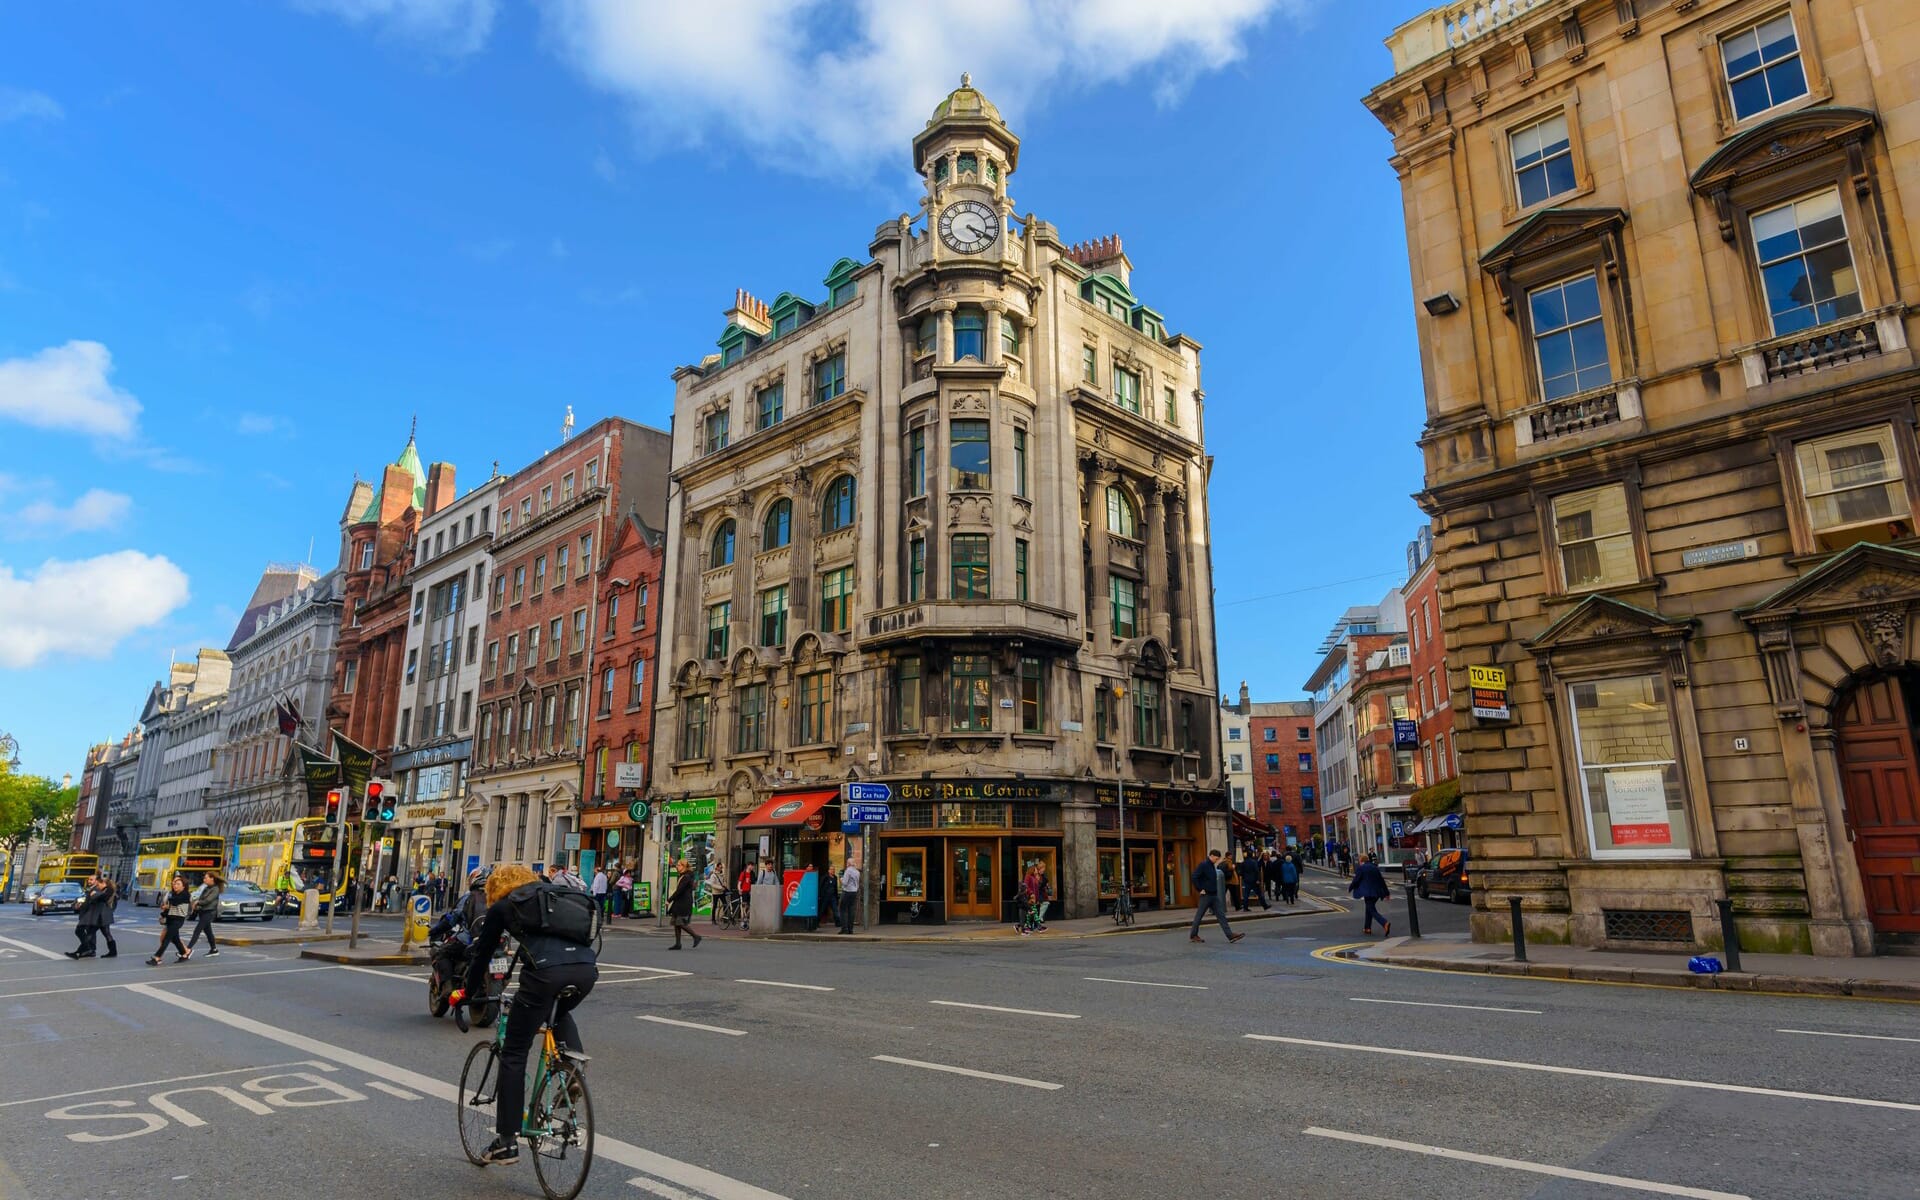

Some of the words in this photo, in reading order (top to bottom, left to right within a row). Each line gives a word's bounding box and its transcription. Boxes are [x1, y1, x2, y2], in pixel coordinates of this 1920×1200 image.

[1471, 669, 1484, 681] TO
[1487, 670, 1504, 683] LET
[1399, 732, 1405, 741] P
[1737, 740, 1745, 749] H
[901, 784, 932, 799] The
[942, 783, 974, 799] Pen
[983, 783, 1041, 797] Corner
[852, 807, 859, 819] P
[44, 1072, 369, 1143] BUS
